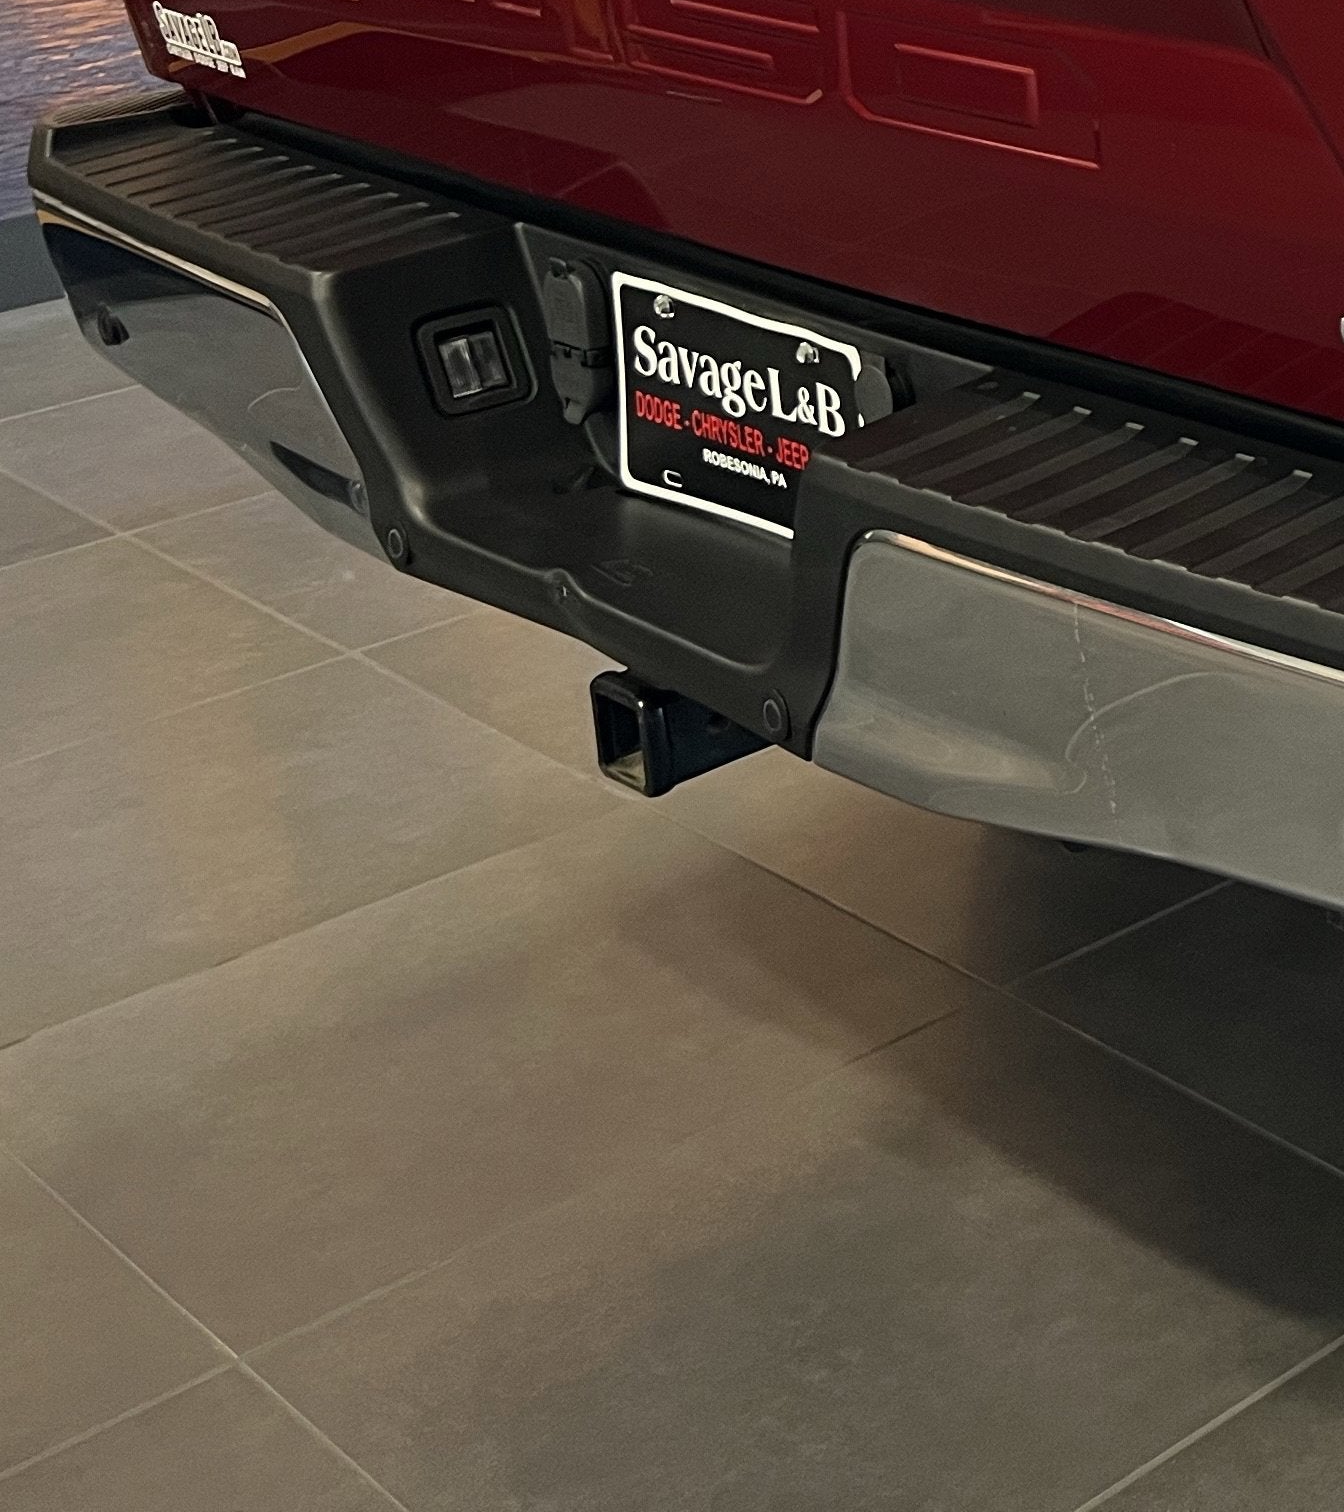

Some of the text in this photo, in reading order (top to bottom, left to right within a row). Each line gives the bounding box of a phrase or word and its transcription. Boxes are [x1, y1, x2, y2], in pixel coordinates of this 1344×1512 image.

[635, 390, 811, 471] DODGE CHRYSLER JEEP
[770, 470, 787, 488] PA
